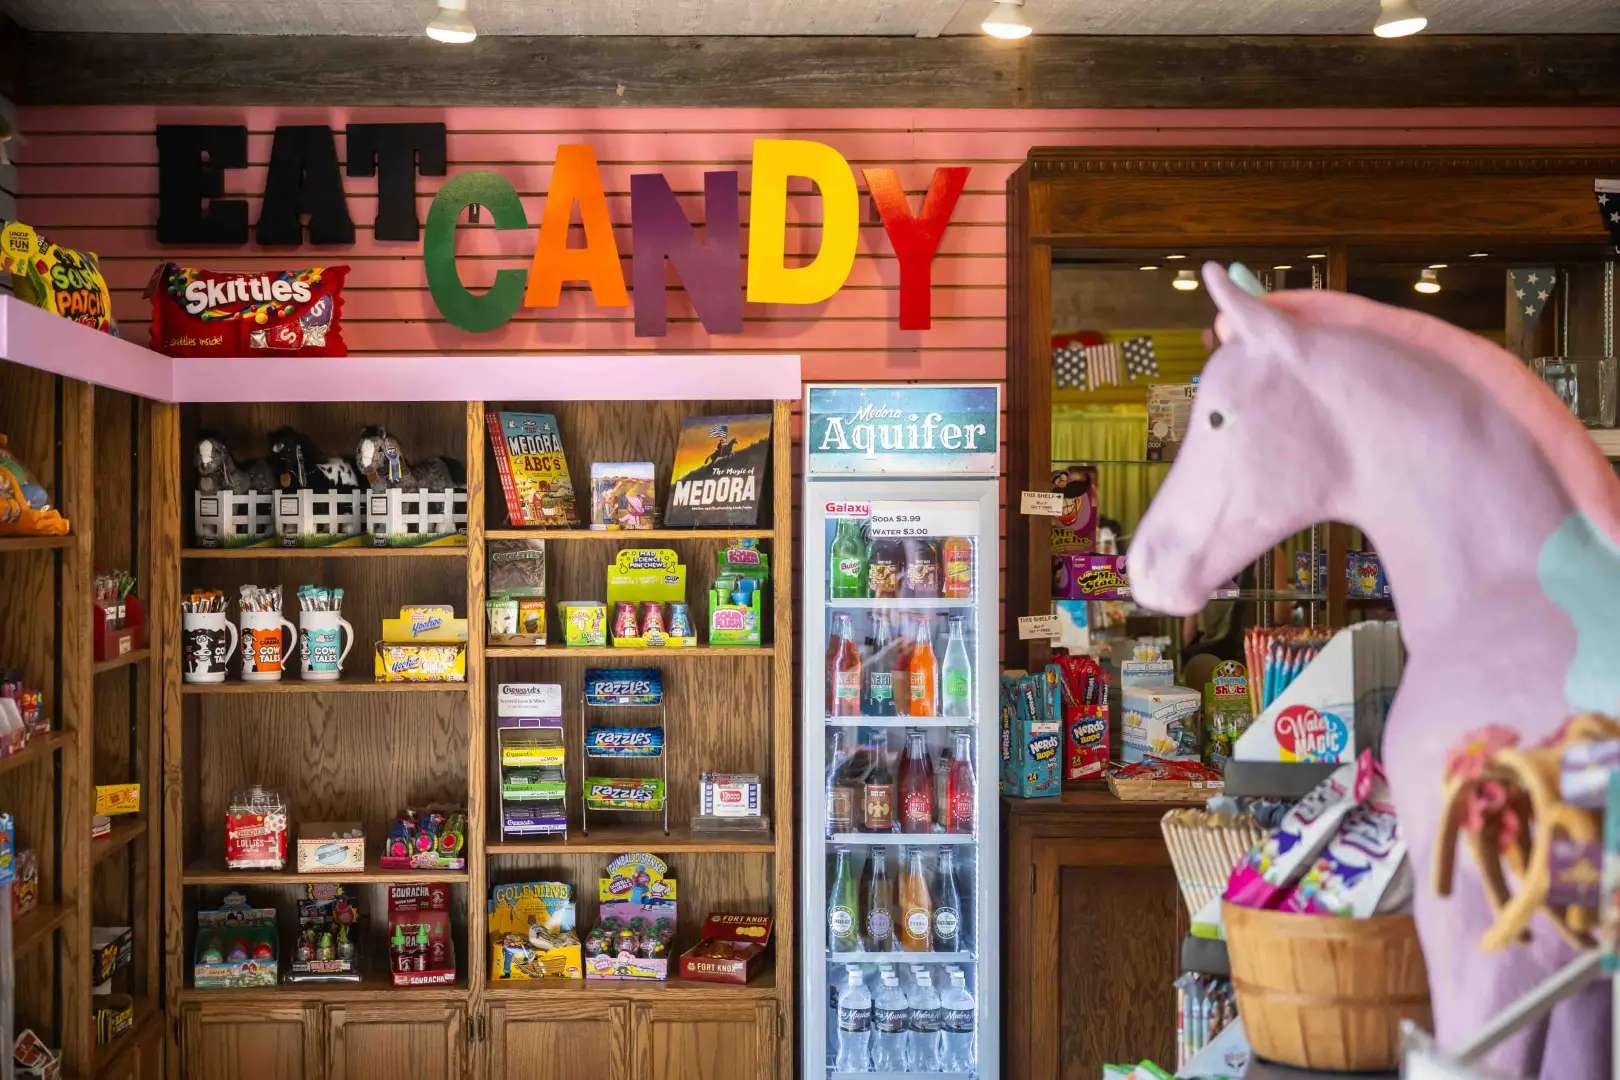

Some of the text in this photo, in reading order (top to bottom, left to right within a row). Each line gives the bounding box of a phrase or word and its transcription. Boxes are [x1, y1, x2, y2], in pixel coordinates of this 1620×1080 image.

[156, 122, 972, 337] EAT CANDY
[9, 240, 29, 250] FUN
[185, 276, 312, 315] Skittles
[845, 404, 903, 426] Medora
[818, 413, 986, 460] Aquifer
[508, 433, 561, 456] MEDORA
[712, 467, 755, 476] The Magic of
[673, 476, 755, 506] MEDORA
[825, 502, 869, 517] Galaxy
[1051, 535, 1092, 545] tache
[1098, 570, 1117, 579] Mr
[214, 647, 226, 655] CO
[259, 646, 280, 655] COW
[314, 646, 336, 655] COW
[259, 654, 281, 663] TALES
[314, 654, 337, 664] TALES
[910, 674, 924, 685] EHI
[1214, 677, 1248, 685] Thumb
[1215, 685, 1246, 695] Shotz
[1277, 709, 1337, 738] Water
[1073, 720, 1105, 739] Nerds
[1079, 732, 1101, 744] Rope
[1029, 736, 1058, 754] Nerds
[1295, 733, 1340, 763] MAGIC
[1036, 749, 1055, 761] Rope
[1071, 757, 1082, 765] 24
[1027, 772, 1037, 781] 24
[236, 839, 265, 848] LOLLIES
[635, 853, 666, 874] DISPENSER
[391, 887, 430, 898] SOURACHA
[496, 884, 568, 902] GOLD MINE
[697, 963, 736, 972] FORT KNOX
[410, 976, 446, 984] SOURACHA
